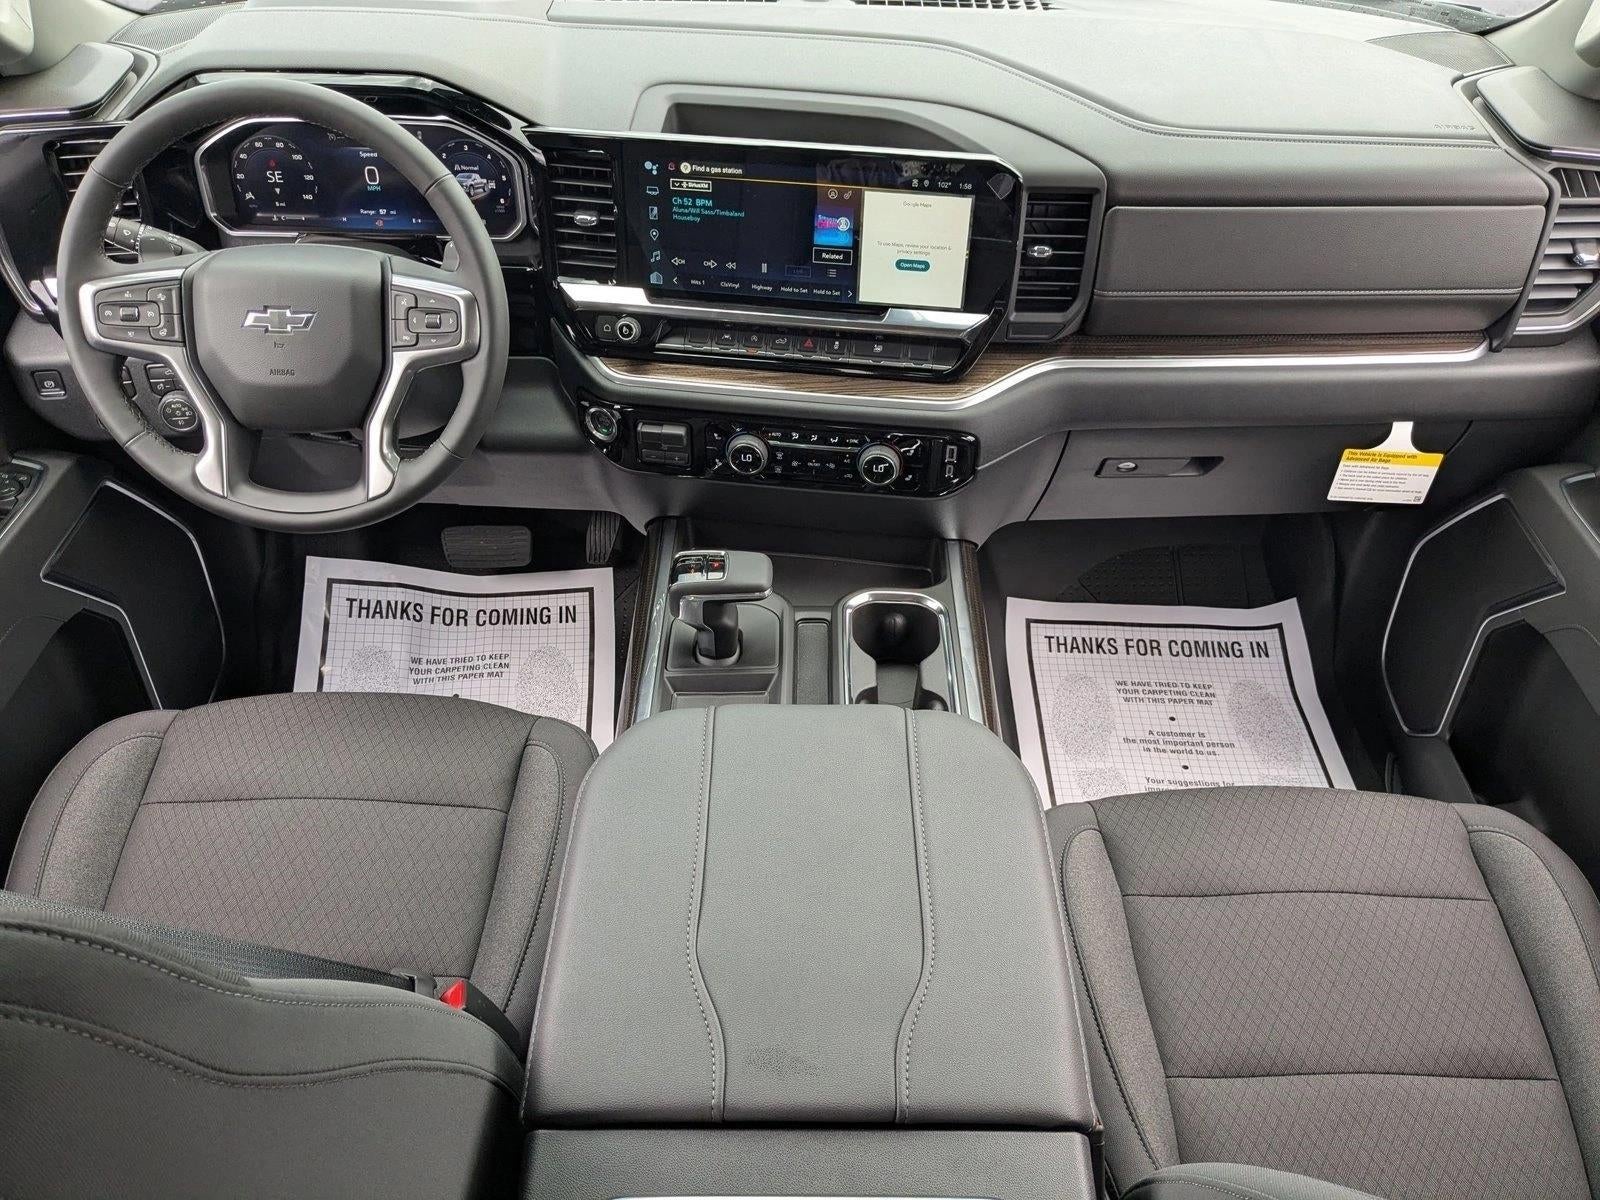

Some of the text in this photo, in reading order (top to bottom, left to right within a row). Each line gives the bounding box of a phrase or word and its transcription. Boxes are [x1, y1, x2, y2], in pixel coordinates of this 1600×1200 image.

[692, 164, 705, 172] Find
[722, 167, 743, 175] station
[266, 170, 284, 183] SE
[364, 166, 380, 185] 0
[959, 182, 973, 190] 1:58
[672, 197, 713, 207] Ch 52 BPM
[821, 252, 844, 261] Related
[751, 283, 773, 292] Highway
[269, 368, 296, 376] AIRBAG
[741, 453, 753, 462] LO
[345, 597, 577, 627] THANKS FOR COMING IN
[1044, 635, 1270, 659] THANKS FOR COMING IN
[410, 653, 510, 666] WE HAVE TRIED TO KEEP
[408, 662, 510, 676] YOUR CARPETING CLEAN
[412, 677, 435, 685] WITH
[436, 675, 456, 683] THIS
[457, 672, 485, 680] PAPER
[1192, 682, 1213, 690] KEEP
[1115, 687, 1216, 698] YOUR CARPETING CLEAN
[1122, 696, 1145, 704] WITH
[1146, 697, 1166, 705] THIS
[1156, 730, 1196, 738] customer
[1162, 738, 1204, 747] important
[1205, 741, 1236, 749] person
[1153, 746, 1167, 754] the
[1169, 747, 1194, 755] world
[1195, 748, 1205, 756] to
[1144, 776, 1165, 785] Your
[1167, 778, 1220, 787] suggestions
